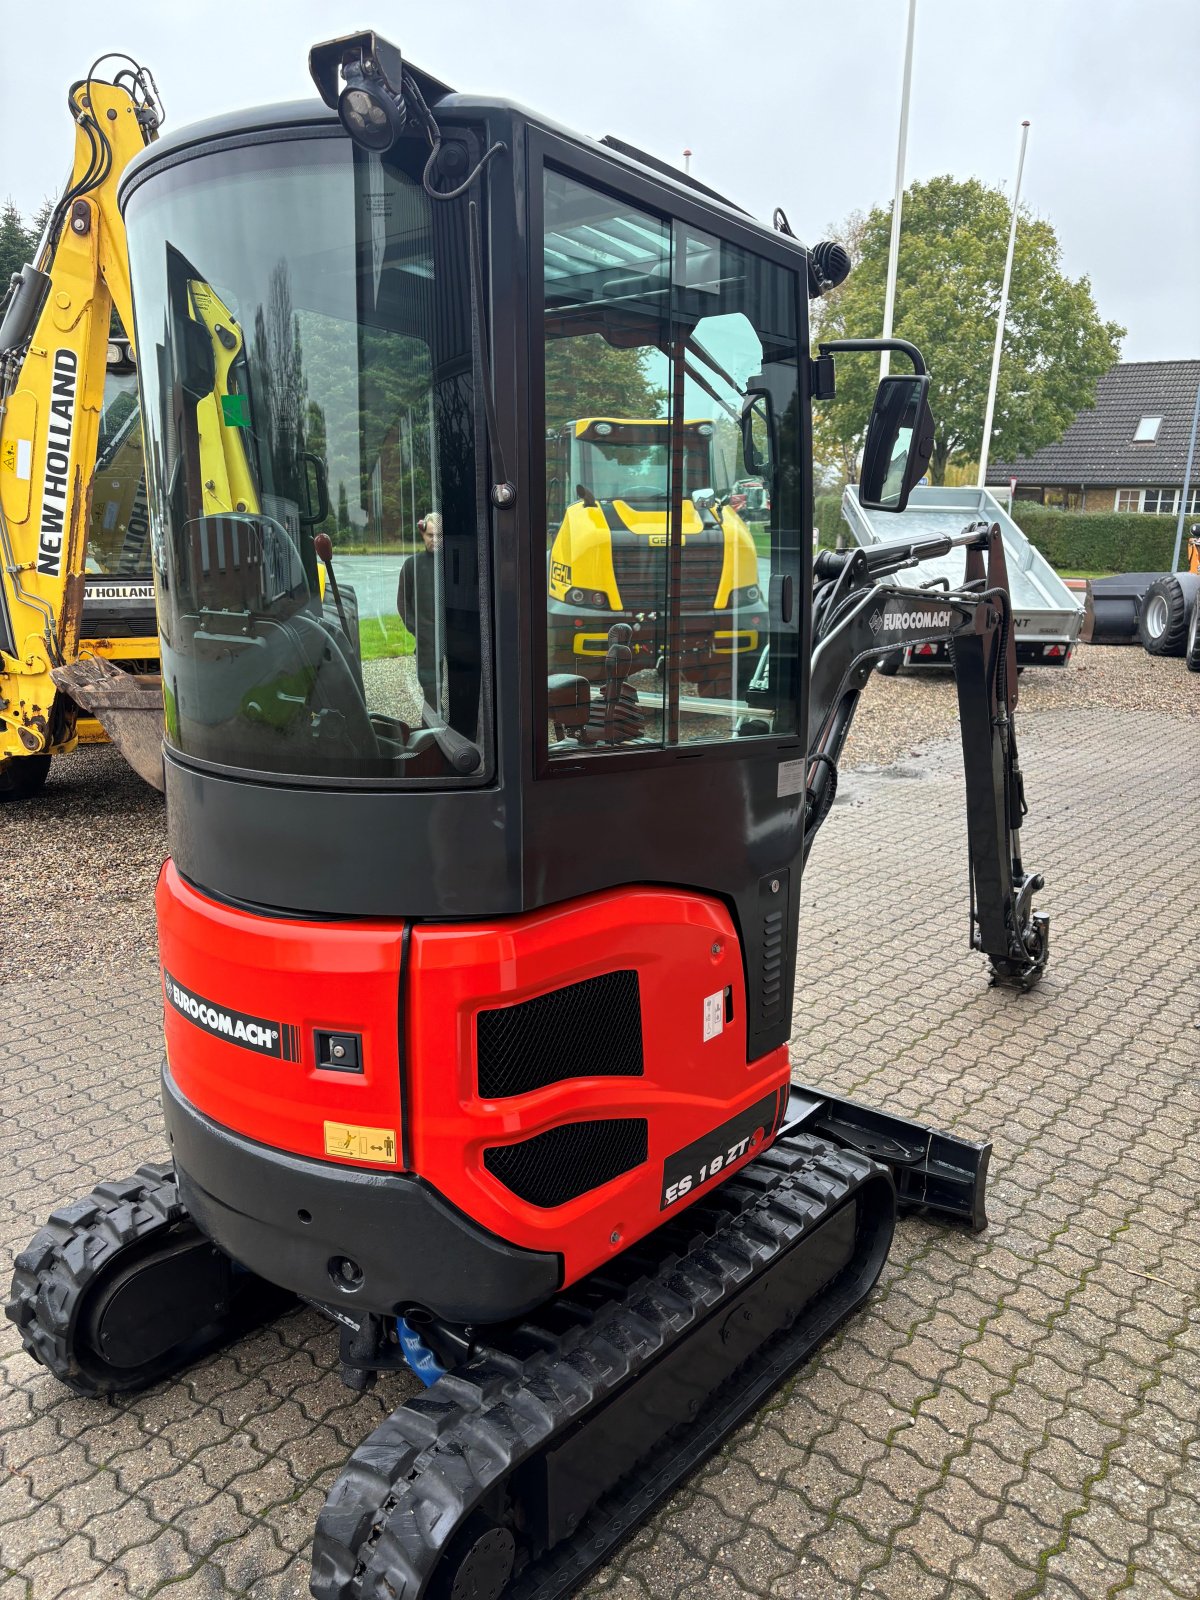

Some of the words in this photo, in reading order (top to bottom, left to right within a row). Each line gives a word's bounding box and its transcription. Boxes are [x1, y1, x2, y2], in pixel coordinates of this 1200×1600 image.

[44, 348, 78, 500] HOLLAND
[37, 503, 67, 577] NEW
[552, 561, 572, 585] GEHL
[96, 587, 155, 598] HOLLAND
[665, 1175, 692, 1205] ES
[699, 1155, 723, 1182] 18
[725, 1136, 749, 1166] ZT
